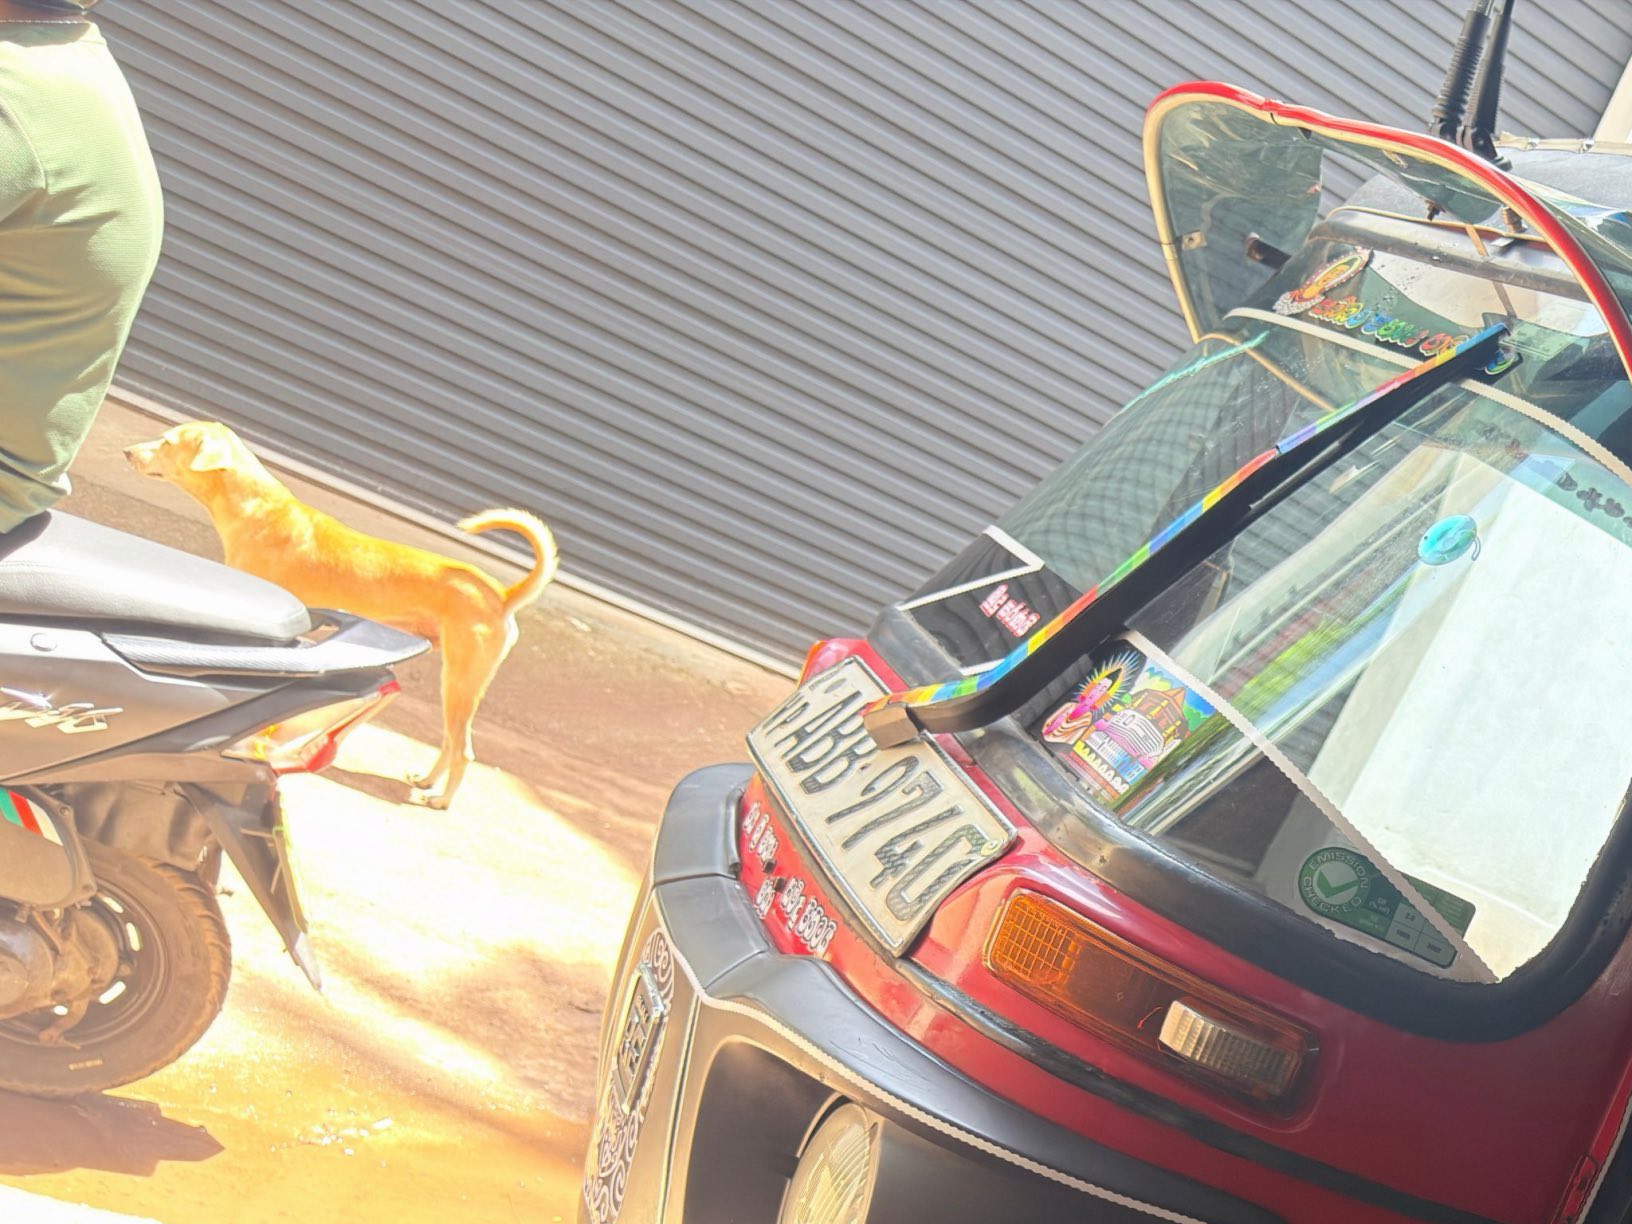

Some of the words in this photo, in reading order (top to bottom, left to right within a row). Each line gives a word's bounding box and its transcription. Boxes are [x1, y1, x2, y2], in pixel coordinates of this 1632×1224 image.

[825, 756, 990, 921] 9740
[1309, 852, 1369, 889] EMISSION
[1303, 876, 1362, 914] CHECKED
